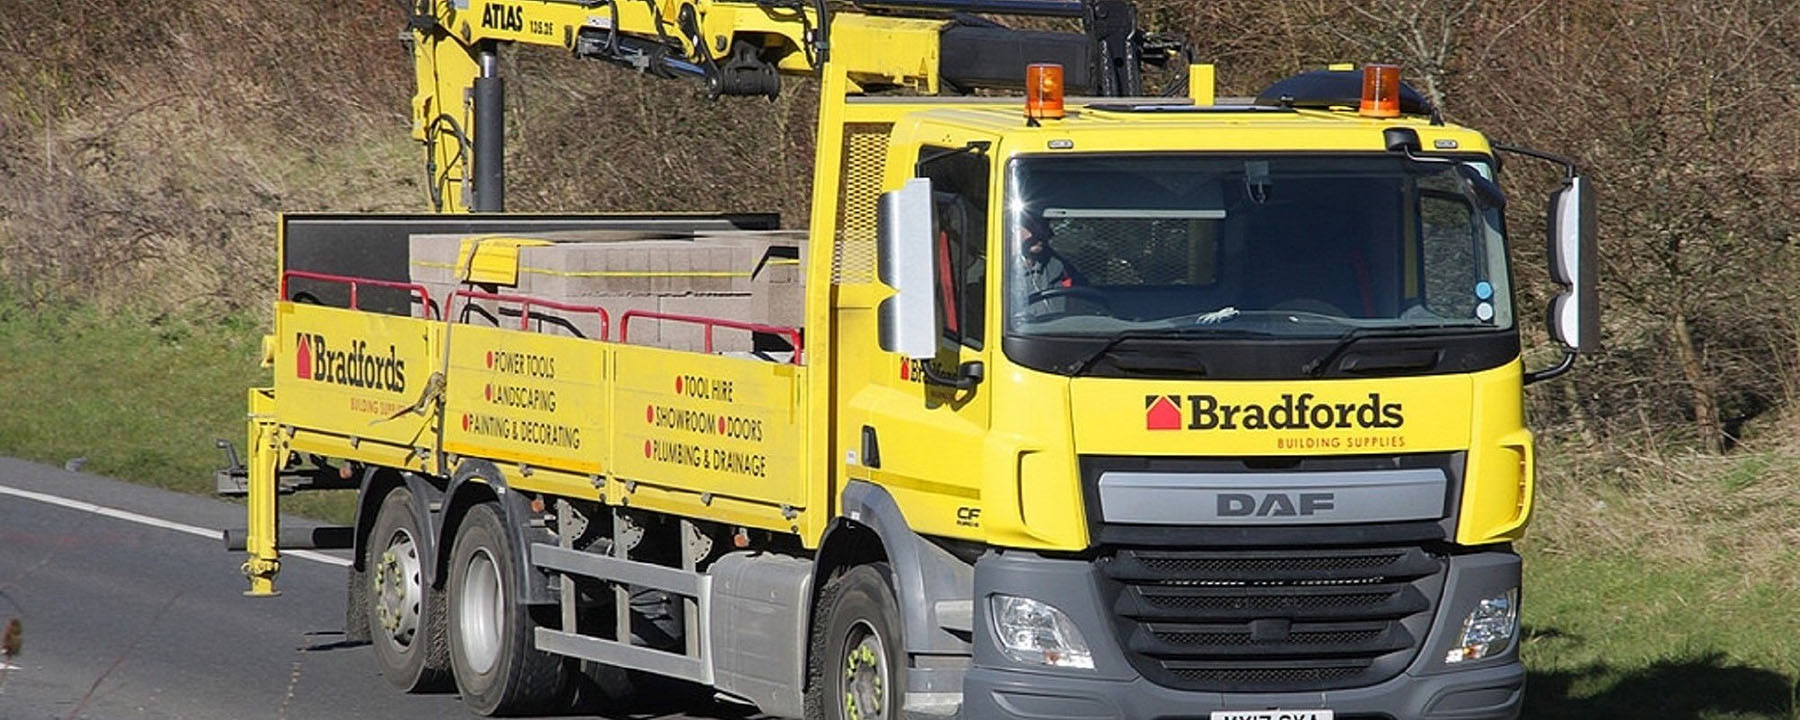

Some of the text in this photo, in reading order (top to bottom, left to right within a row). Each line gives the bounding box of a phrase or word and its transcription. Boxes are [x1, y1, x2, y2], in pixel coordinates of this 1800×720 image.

[481, 2, 523, 32] ATLAS
[314, 333, 405, 393] Bradfords
[494, 351, 554, 379] POWER TOOLS
[492, 384, 556, 412] LANDSCAPING
[684, 375, 733, 402] TOOL HIRE
[656, 406, 762, 442] SHOWROOM DOORS
[1187, 393, 1404, 430] Bradfords
[468, 413, 580, 449] PAINTING & DECORATING
[1277, 436, 1406, 449] BUILDING SUPPLIES
[653, 439, 766, 477] PLUMBING & DRAINAGE
[957, 507, 981, 520] CF
[1216, 493, 1335, 517] DAF
